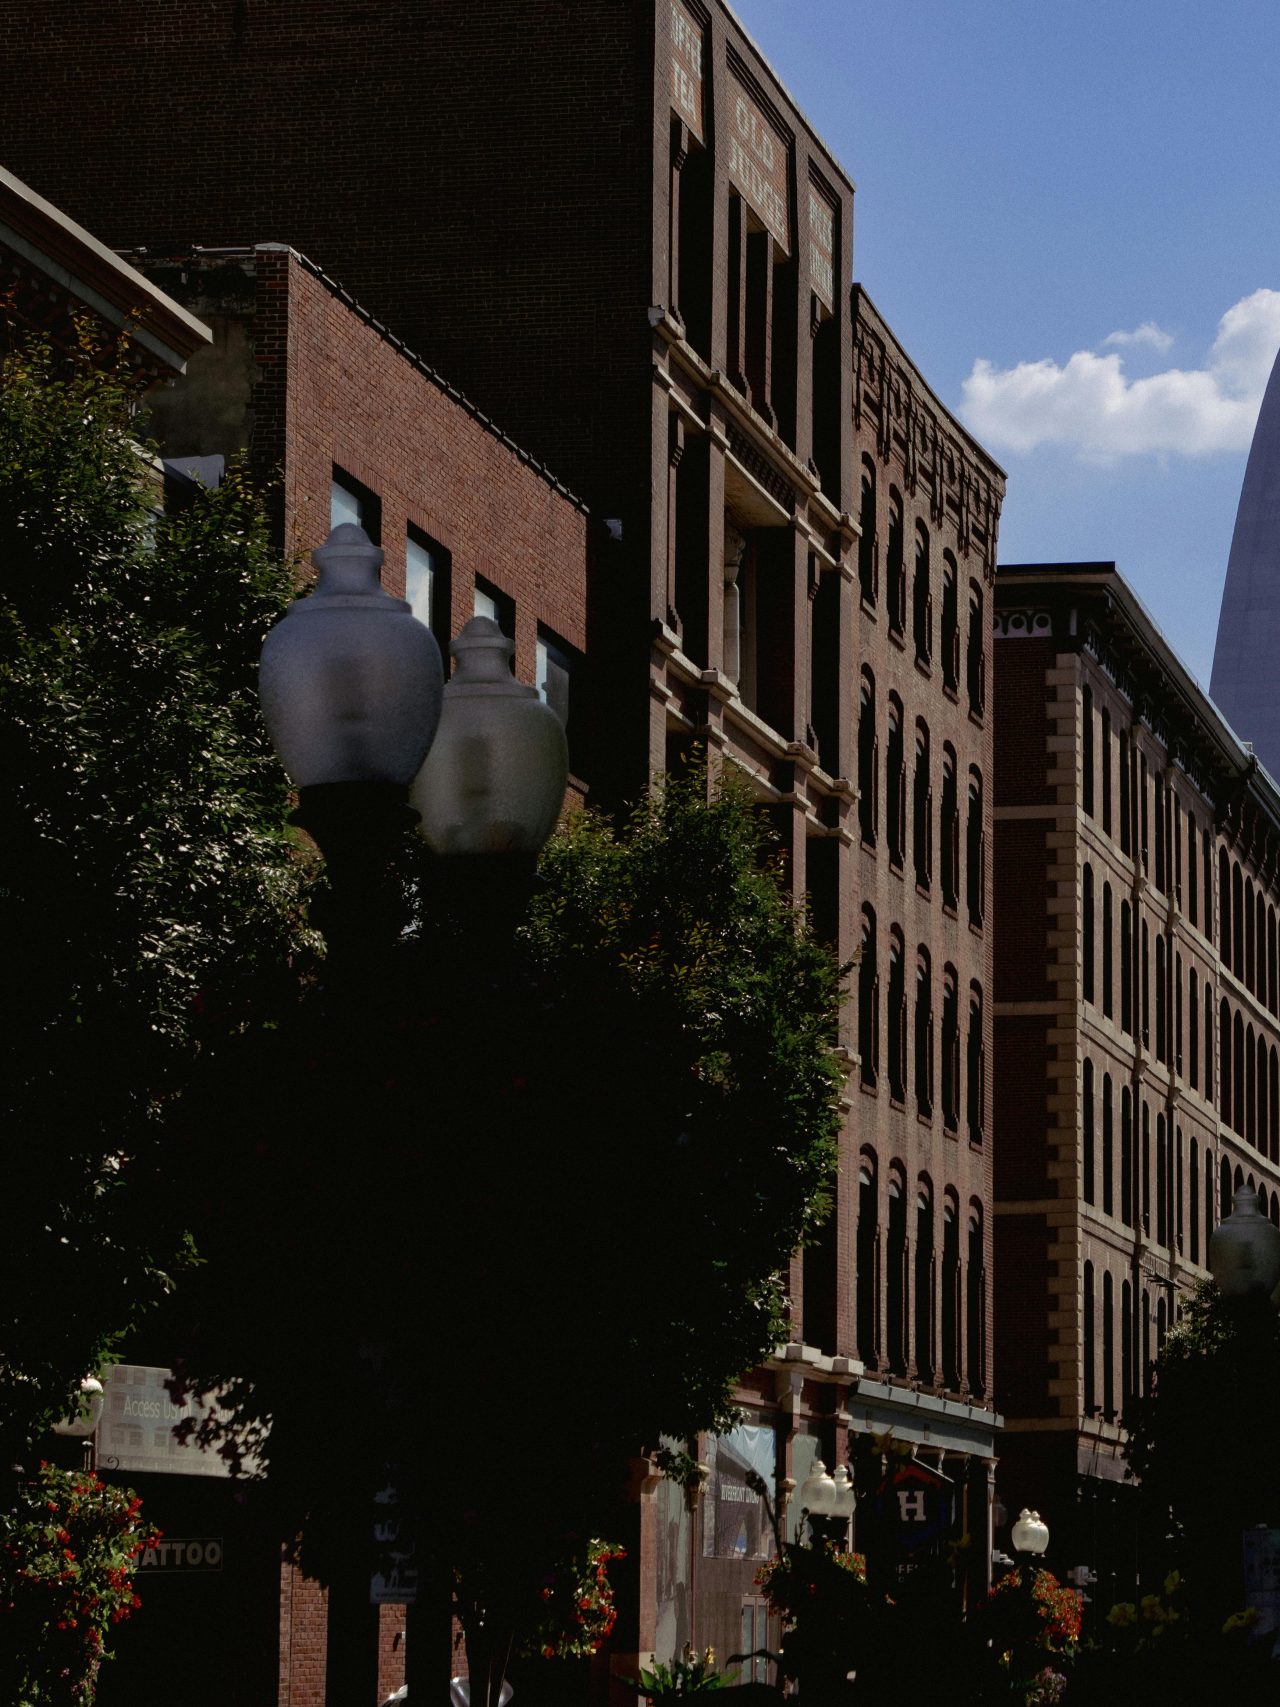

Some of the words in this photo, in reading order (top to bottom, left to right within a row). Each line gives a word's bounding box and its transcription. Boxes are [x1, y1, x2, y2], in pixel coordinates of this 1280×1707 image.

[735, 97, 774, 173] OLD
[123, 1395, 160, 1418] Access
[896, 1490, 927, 1522] H
